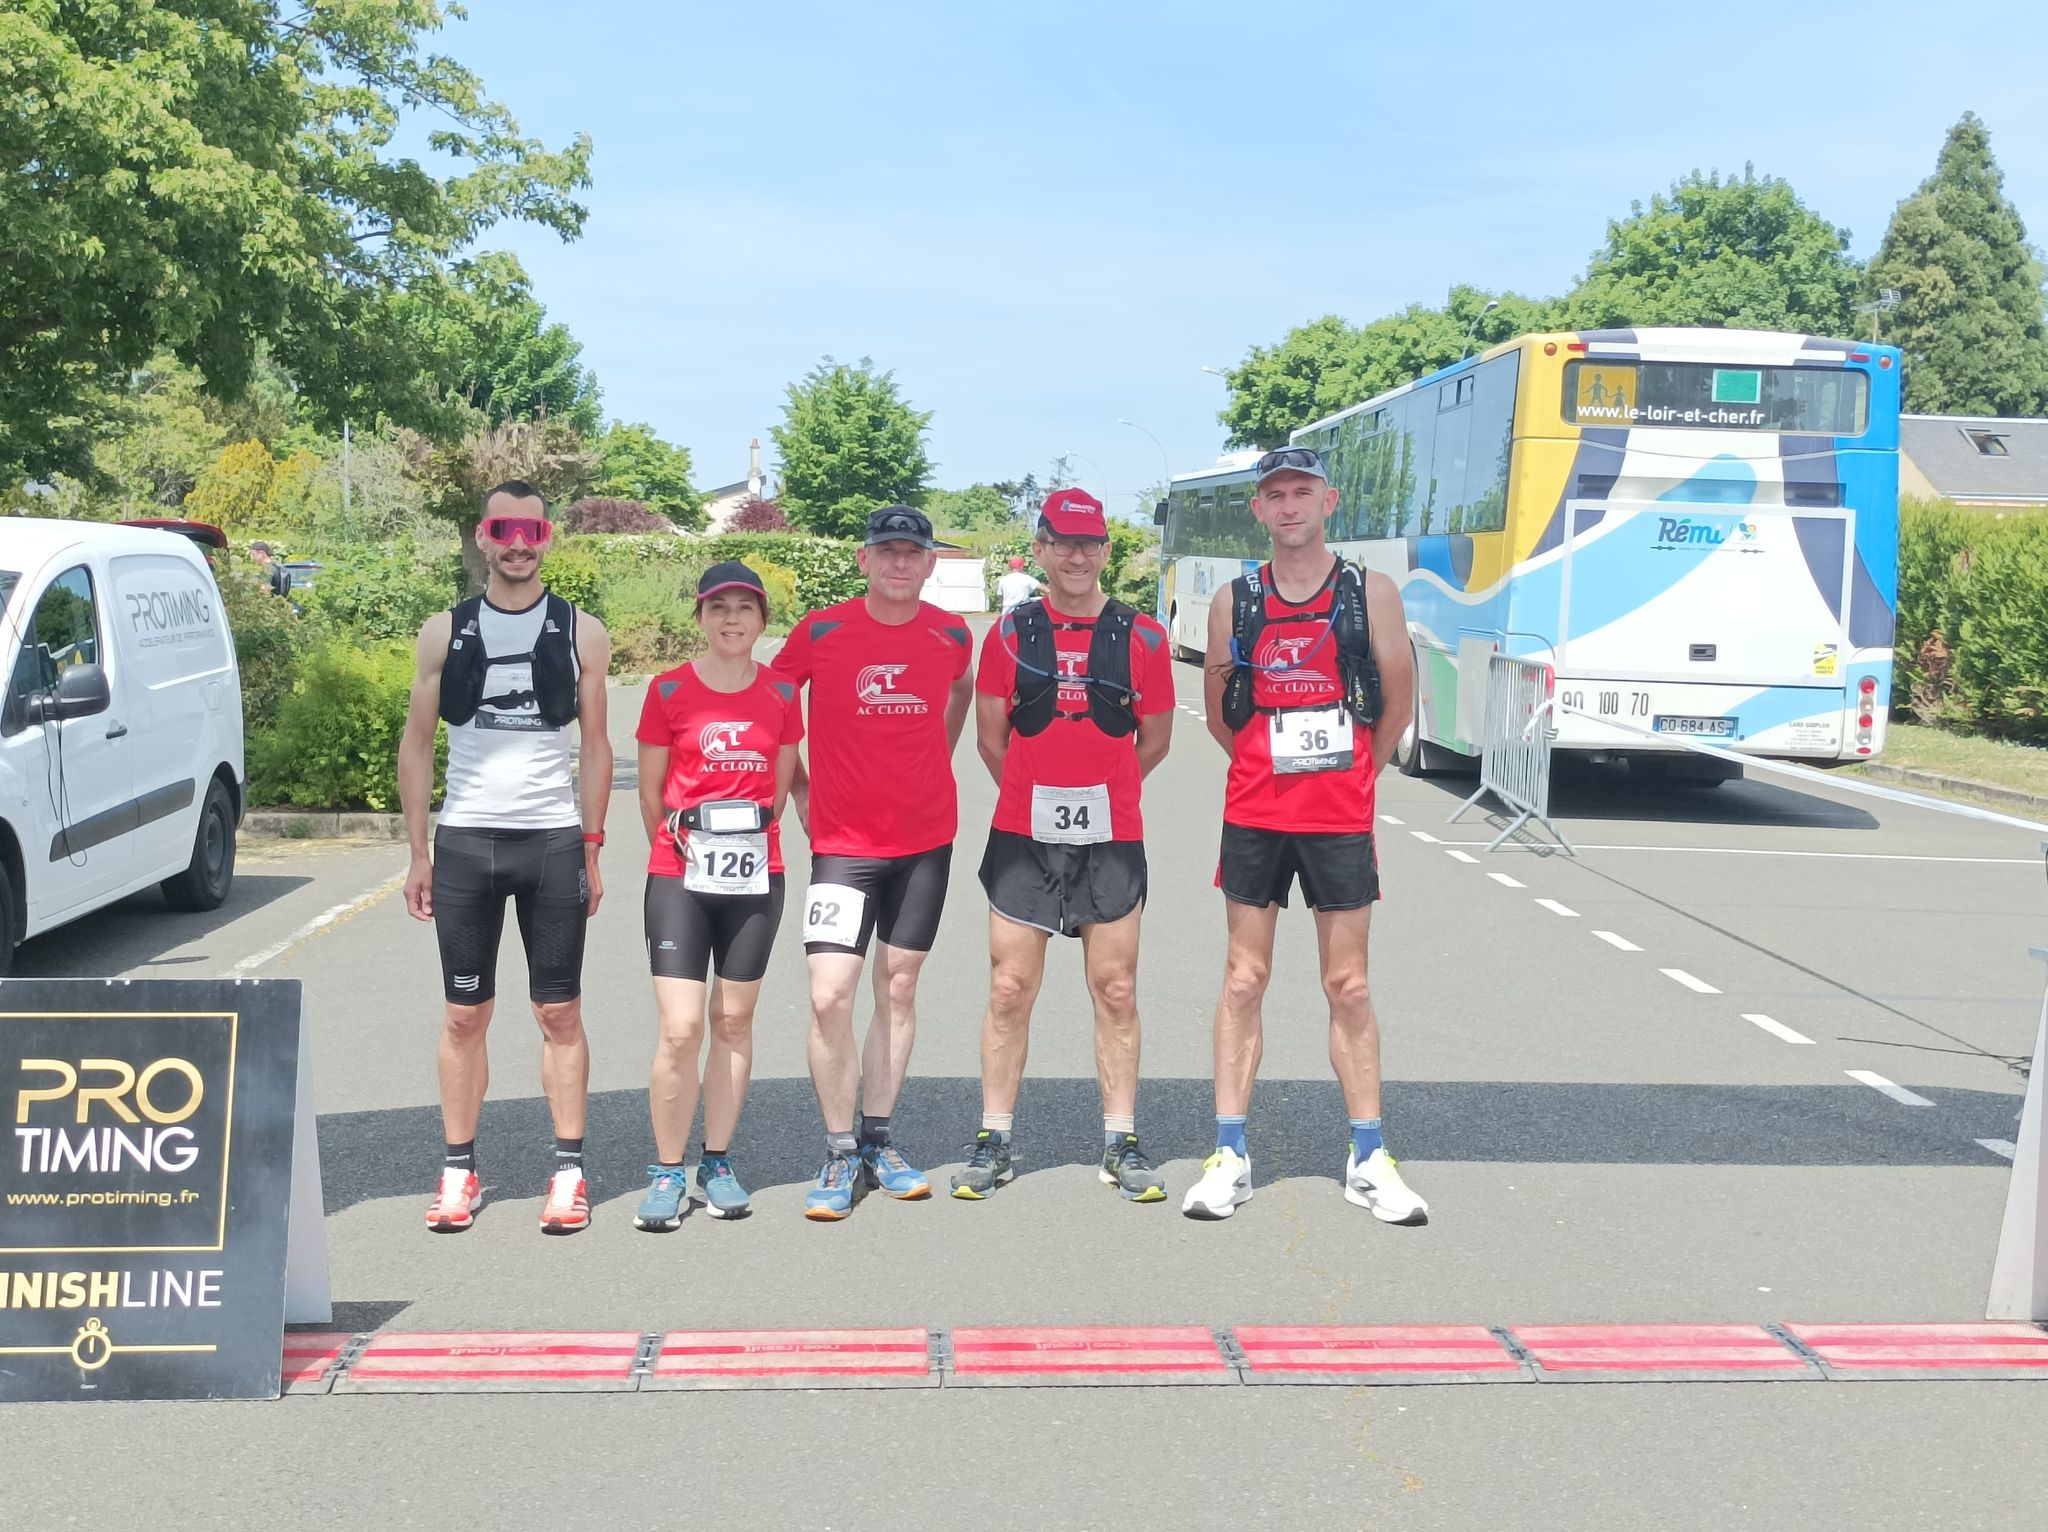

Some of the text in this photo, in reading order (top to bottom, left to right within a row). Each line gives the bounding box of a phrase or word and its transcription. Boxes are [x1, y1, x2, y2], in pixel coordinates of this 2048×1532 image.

[1576, 404, 1766, 425] www.le-loir-et-cher.fr
[125, 588, 210, 633] PROTIMING
[1057, 690, 1088, 702] CLOY
[1264, 682, 1335, 694] AC CLOYES
[857, 704, 929, 715] AC CLOYES
[1598, 691, 1619, 715] 100
[1631, 692, 1649, 716] 70
[1300, 729, 1329, 751] 36
[700, 761, 768, 773] AC CLOYES
[1054, 805, 1090, 830] 34
[703, 851, 755, 878] 126
[809, 901, 841, 927] 62
[15, 1057, 204, 1124] PRO
[15, 1127, 200, 1173] TIMING
[7, 1189, 200, 1206] www.protiming.fr
